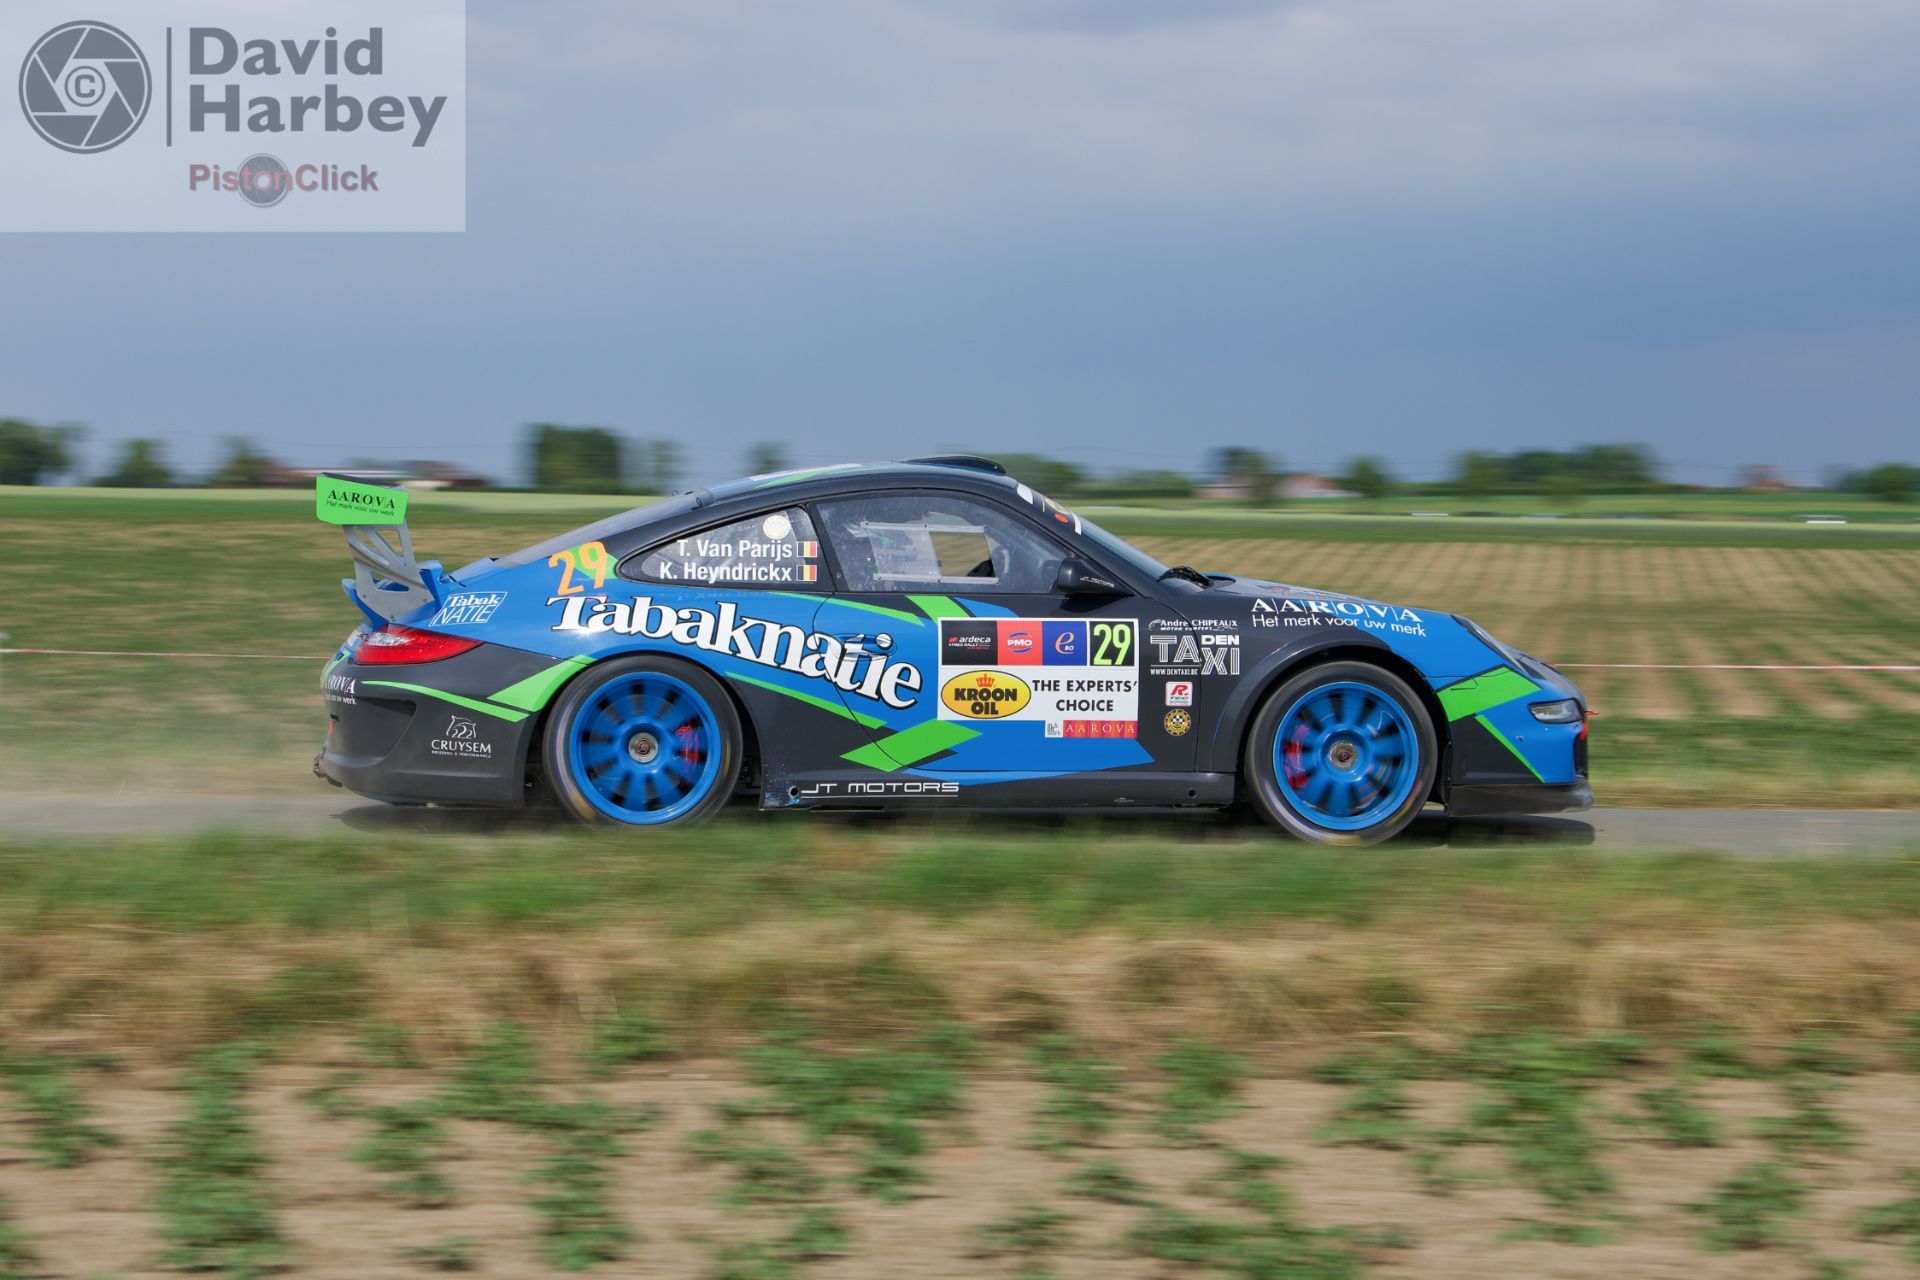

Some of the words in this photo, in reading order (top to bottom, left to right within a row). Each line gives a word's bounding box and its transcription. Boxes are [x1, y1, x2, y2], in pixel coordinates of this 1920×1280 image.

[327, 489, 395, 509] AAROVA
[676, 540, 691, 557] T.
[697, 540, 734, 557] Van
[739, 539, 793, 562] Parijs
[548, 541, 608, 595] 29
[659, 563, 678, 580] K.
[683, 562, 792, 584] Heyndrickx
[449, 594, 501, 607] Tabak
[432, 605, 496, 624] NATIE
[1252, 614, 1279, 628] Het
[1284, 613, 1322, 627] merk
[1326, 617, 1358, 627] voor
[1363, 619, 1387, 630] uw
[1391, 622, 1427, 638] merk
[1093, 624, 1131, 666] 29
[1201, 635, 1240, 645] DEN
[545, 596, 922, 710] Tabaknatie
[1150, 668, 1198, 676] WWW.DENTAXI.BE
[1033, 680, 1060, 692] THE
[1066, 680, 1138, 692] EXPERTS'
[954, 688, 1018, 702] KROON
[971, 702, 999, 715] OIL
[1056, 700, 1114, 712] CHOICE
[1066, 723, 1135, 734] AAROVA
[431, 739, 492, 754] CRUYSEM
[801, 783, 837, 793] JT
[848, 782, 960, 793] MOTORS
